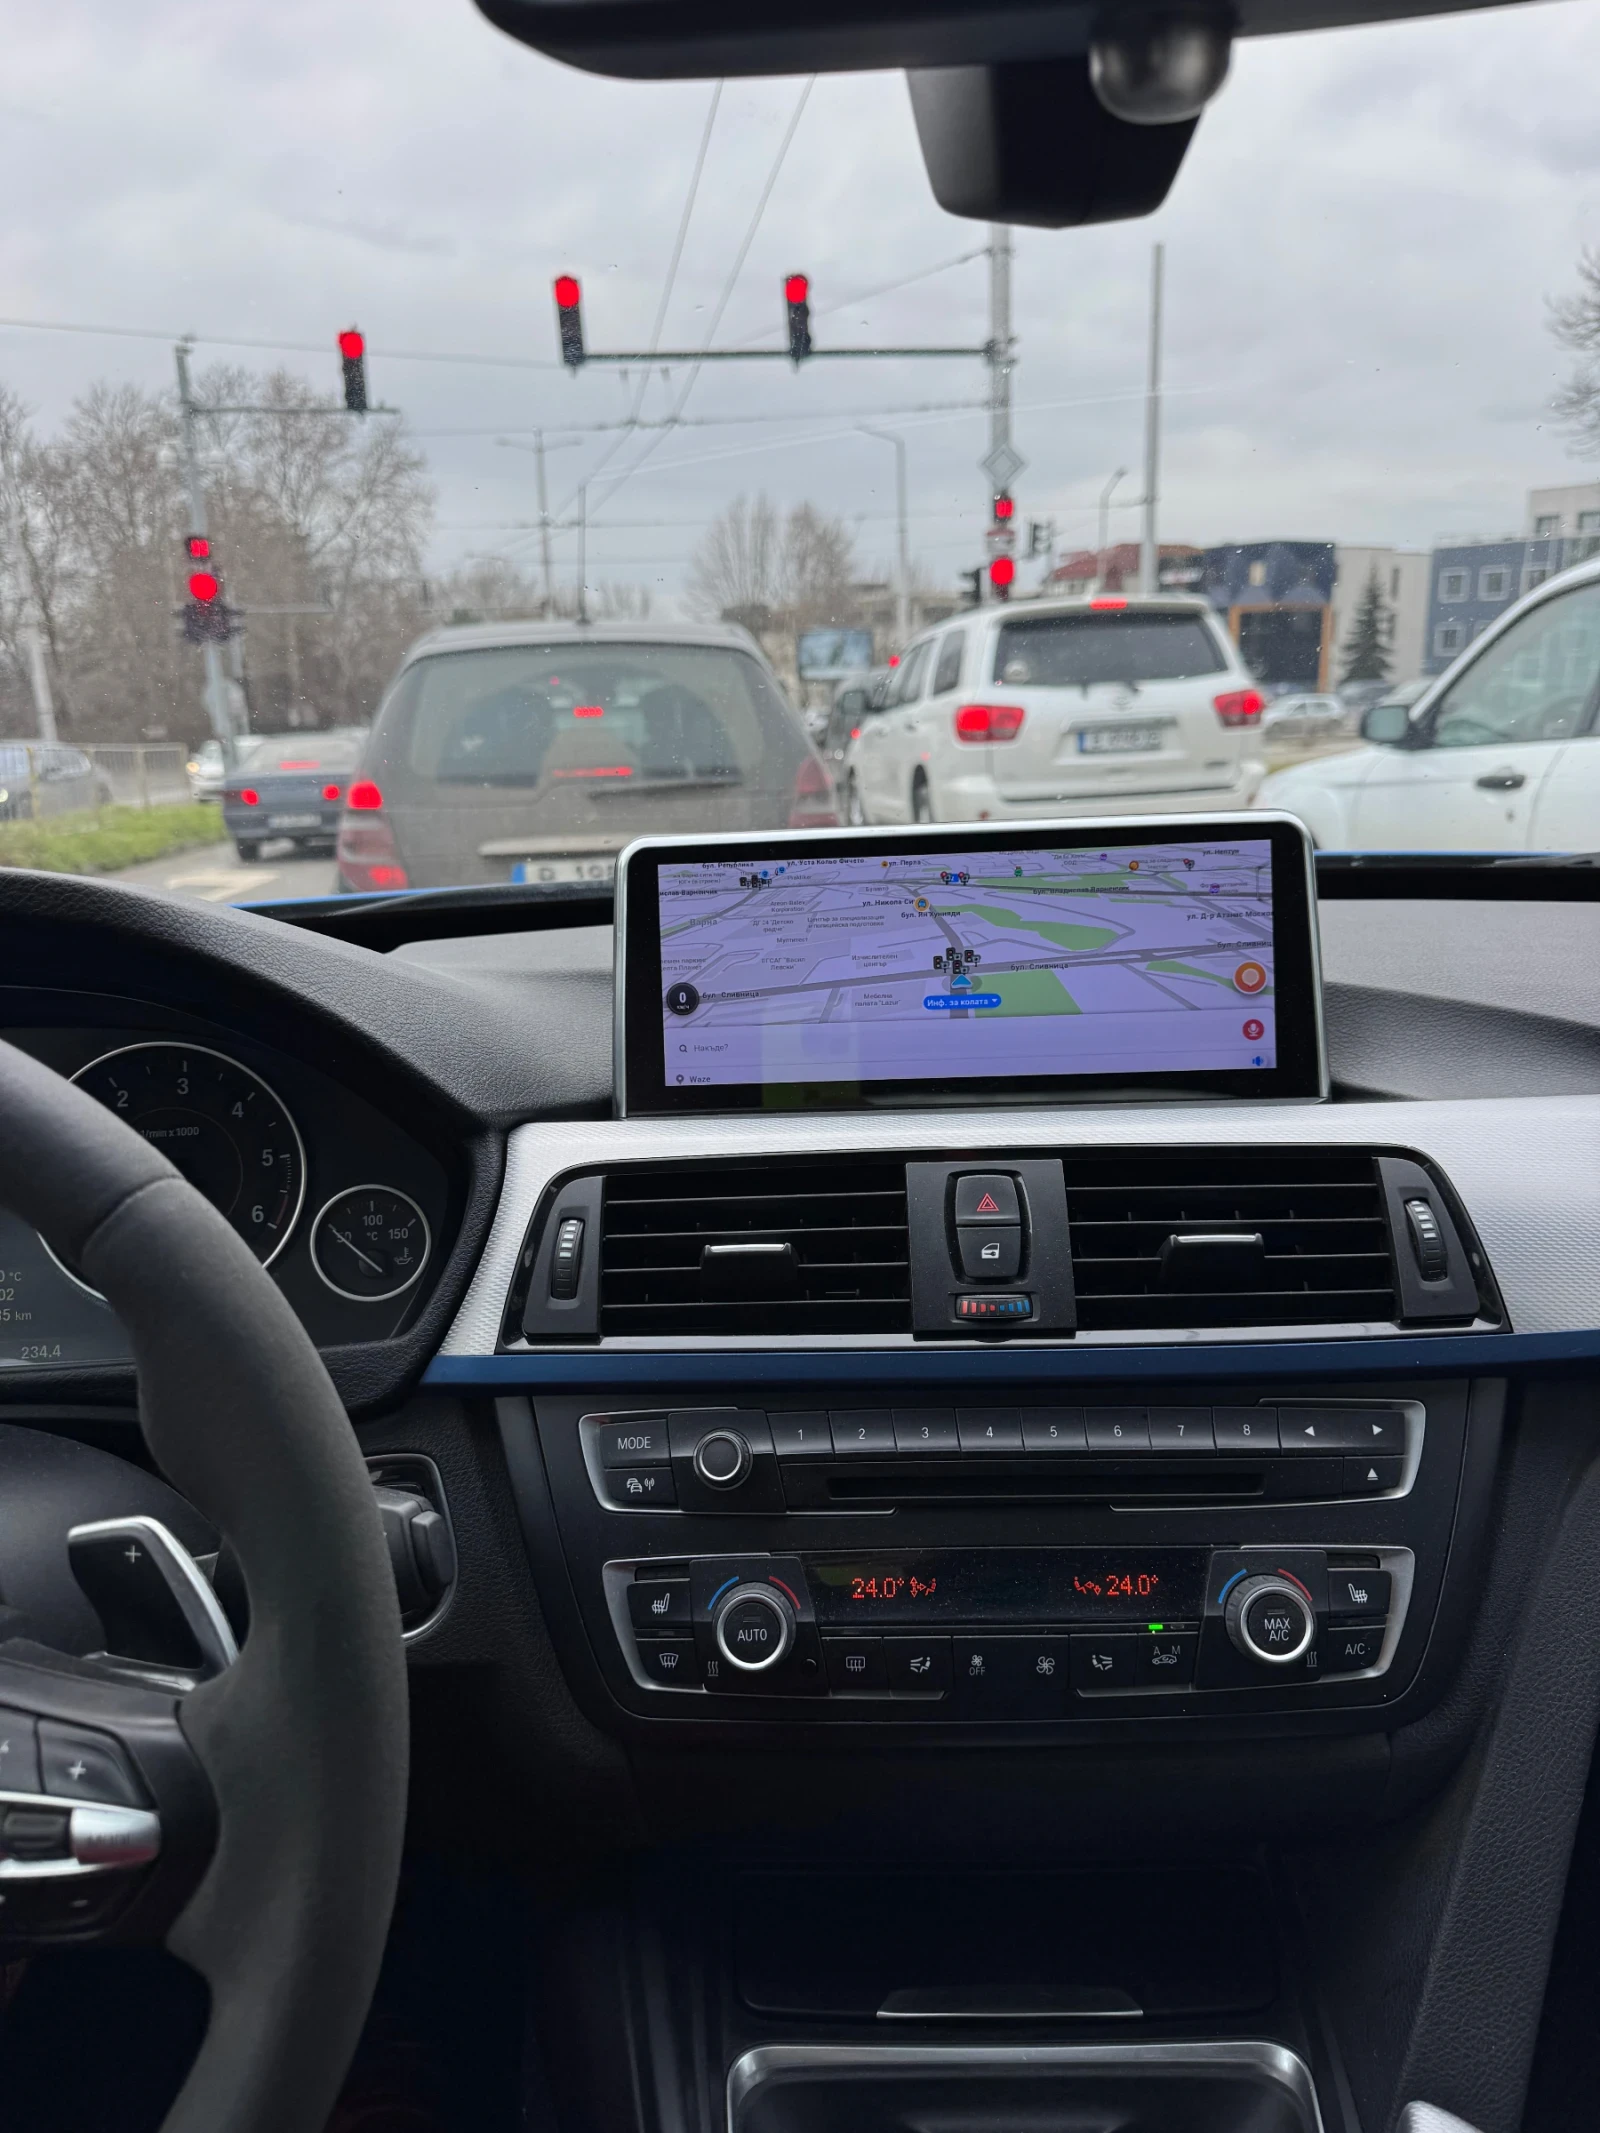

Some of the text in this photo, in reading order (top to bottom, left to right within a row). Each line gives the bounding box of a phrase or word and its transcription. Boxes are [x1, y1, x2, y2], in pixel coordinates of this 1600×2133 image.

[718, 862, 754, 870] Република
[690, 918, 718, 927] Варна
[680, 991, 687, 1003] 0
[694, 1044, 729, 1052] Накъде?
[689, 1075, 711, 1083] Waze
[178, 1079, 190, 1096] 3
[117, 1090, 130, 1108] 2
[231, 1101, 245, 1119] 4
[176, 1126, 200, 1137] 1000
[261, 1149, 274, 1166] 5
[251, 1206, 265, 1223] 6
[362, 1214, 383, 1226] 100
[388, 1227, 409, 1240] 150
[15, 1311, 32, 1321] km
[21, 1345, 62, 1359] 234.4
[797, 1428, 804, 1440] 1
[857, 1427, 866, 1441] 2
[921, 1426, 930, 1439] 3
[986, 1426, 994, 1438] 4
[1050, 1425, 1058, 1438] 5
[1113, 1424, 1122, 1438] 6
[1177, 1424, 1185, 1436] 7
[1243, 1423, 1251, 1436] 8
[617, 1436, 652, 1451] MODE
[1264, 1618, 1291, 1630] MAX
[737, 1627, 768, 1643] AUTO
[1269, 1630, 1289, 1642] A/C
[1153, 1644, 1181, 1655] A M
[1345, 1642, 1366, 1656] A/C
[968, 1664, 986, 1677] OFF
